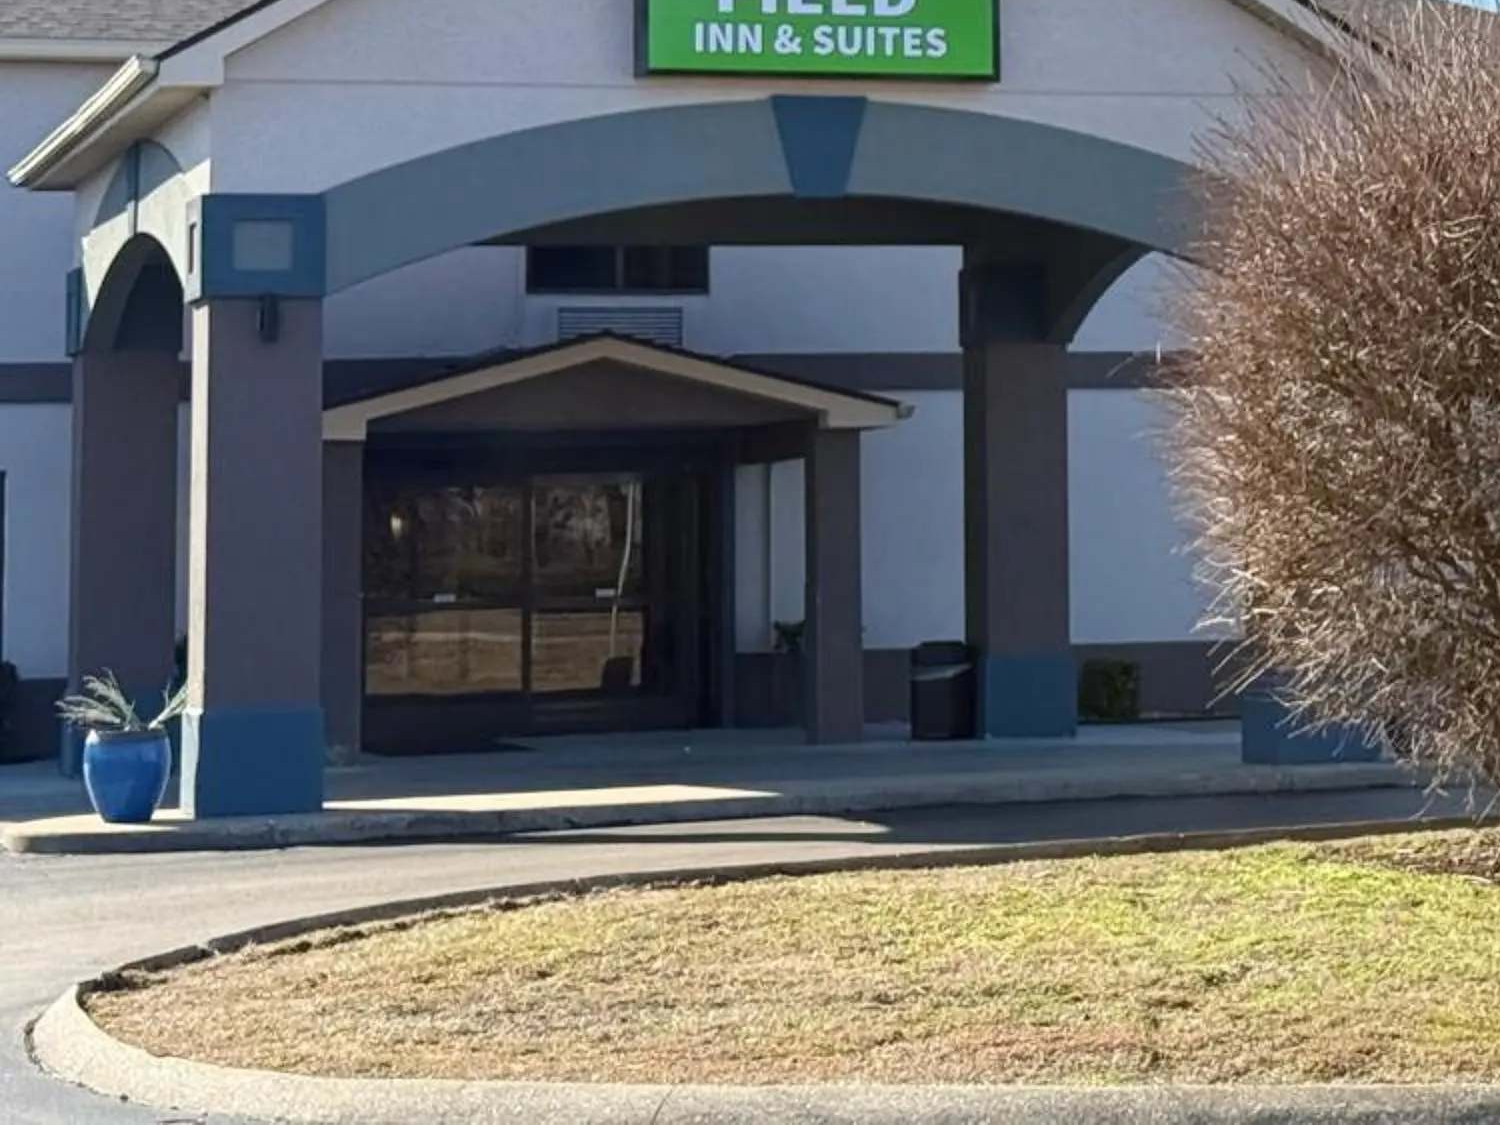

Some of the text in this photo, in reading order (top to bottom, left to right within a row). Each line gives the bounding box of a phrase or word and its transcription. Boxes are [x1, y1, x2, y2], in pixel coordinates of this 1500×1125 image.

[694, 21, 948, 58] INN & SUITES
